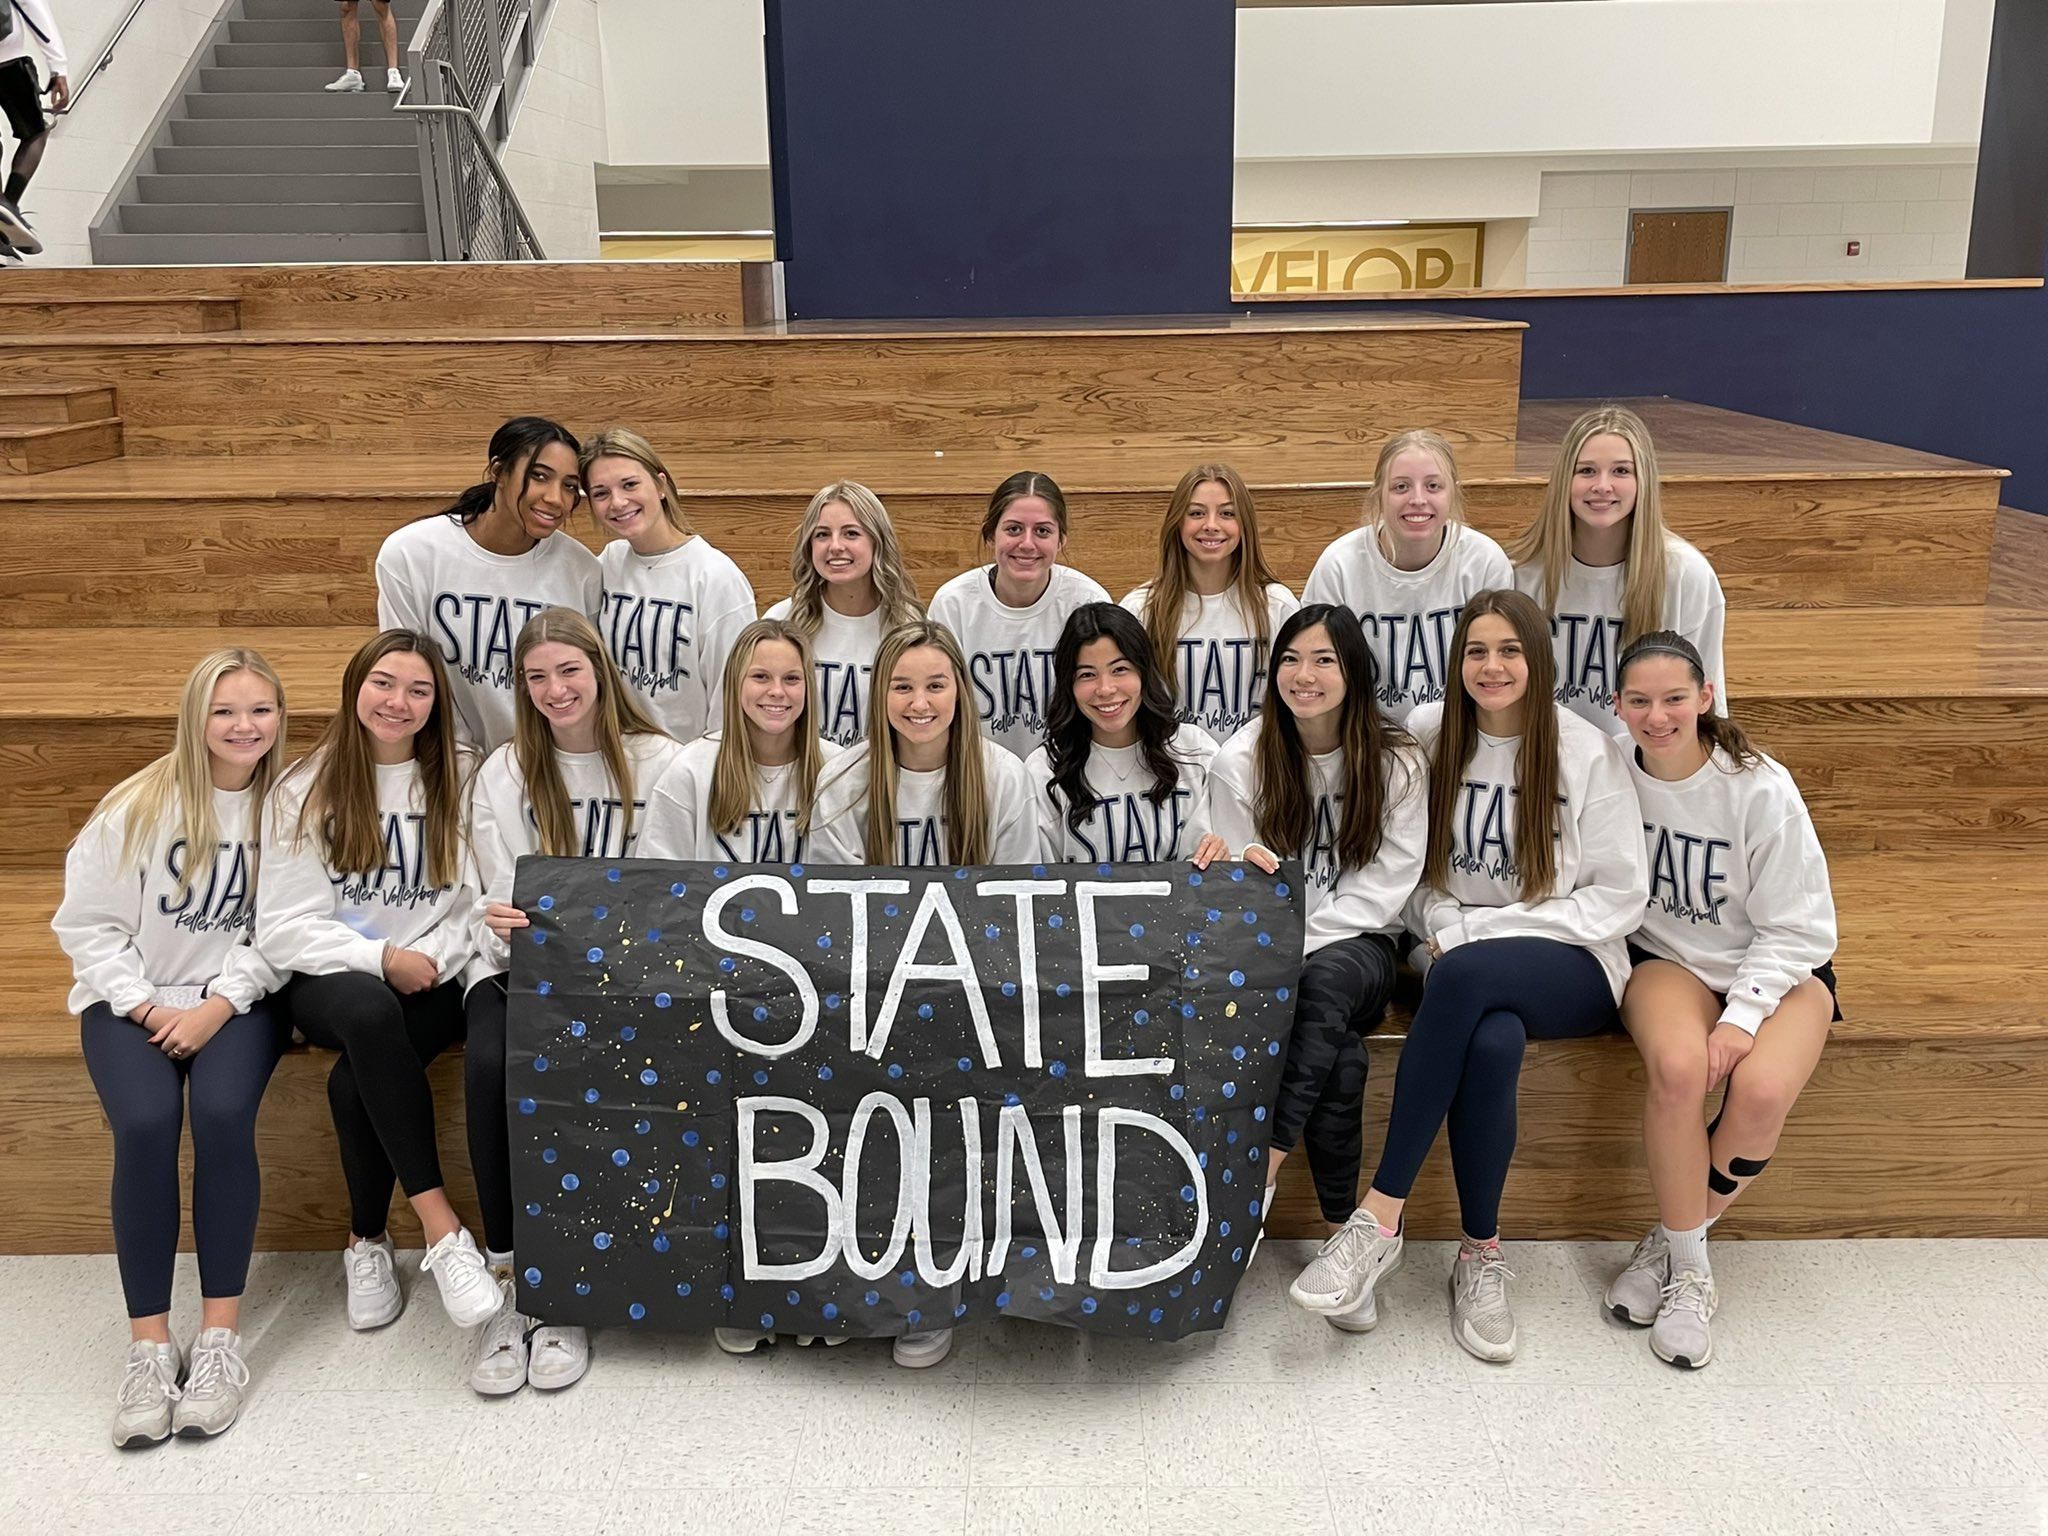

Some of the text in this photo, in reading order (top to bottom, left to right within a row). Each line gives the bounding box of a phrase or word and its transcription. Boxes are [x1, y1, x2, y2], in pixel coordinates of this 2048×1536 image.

[341, 882, 378, 905] Keller
[702, 874, 1175, 1077] STATE
[734, 1091, 1209, 1289] BOUND
